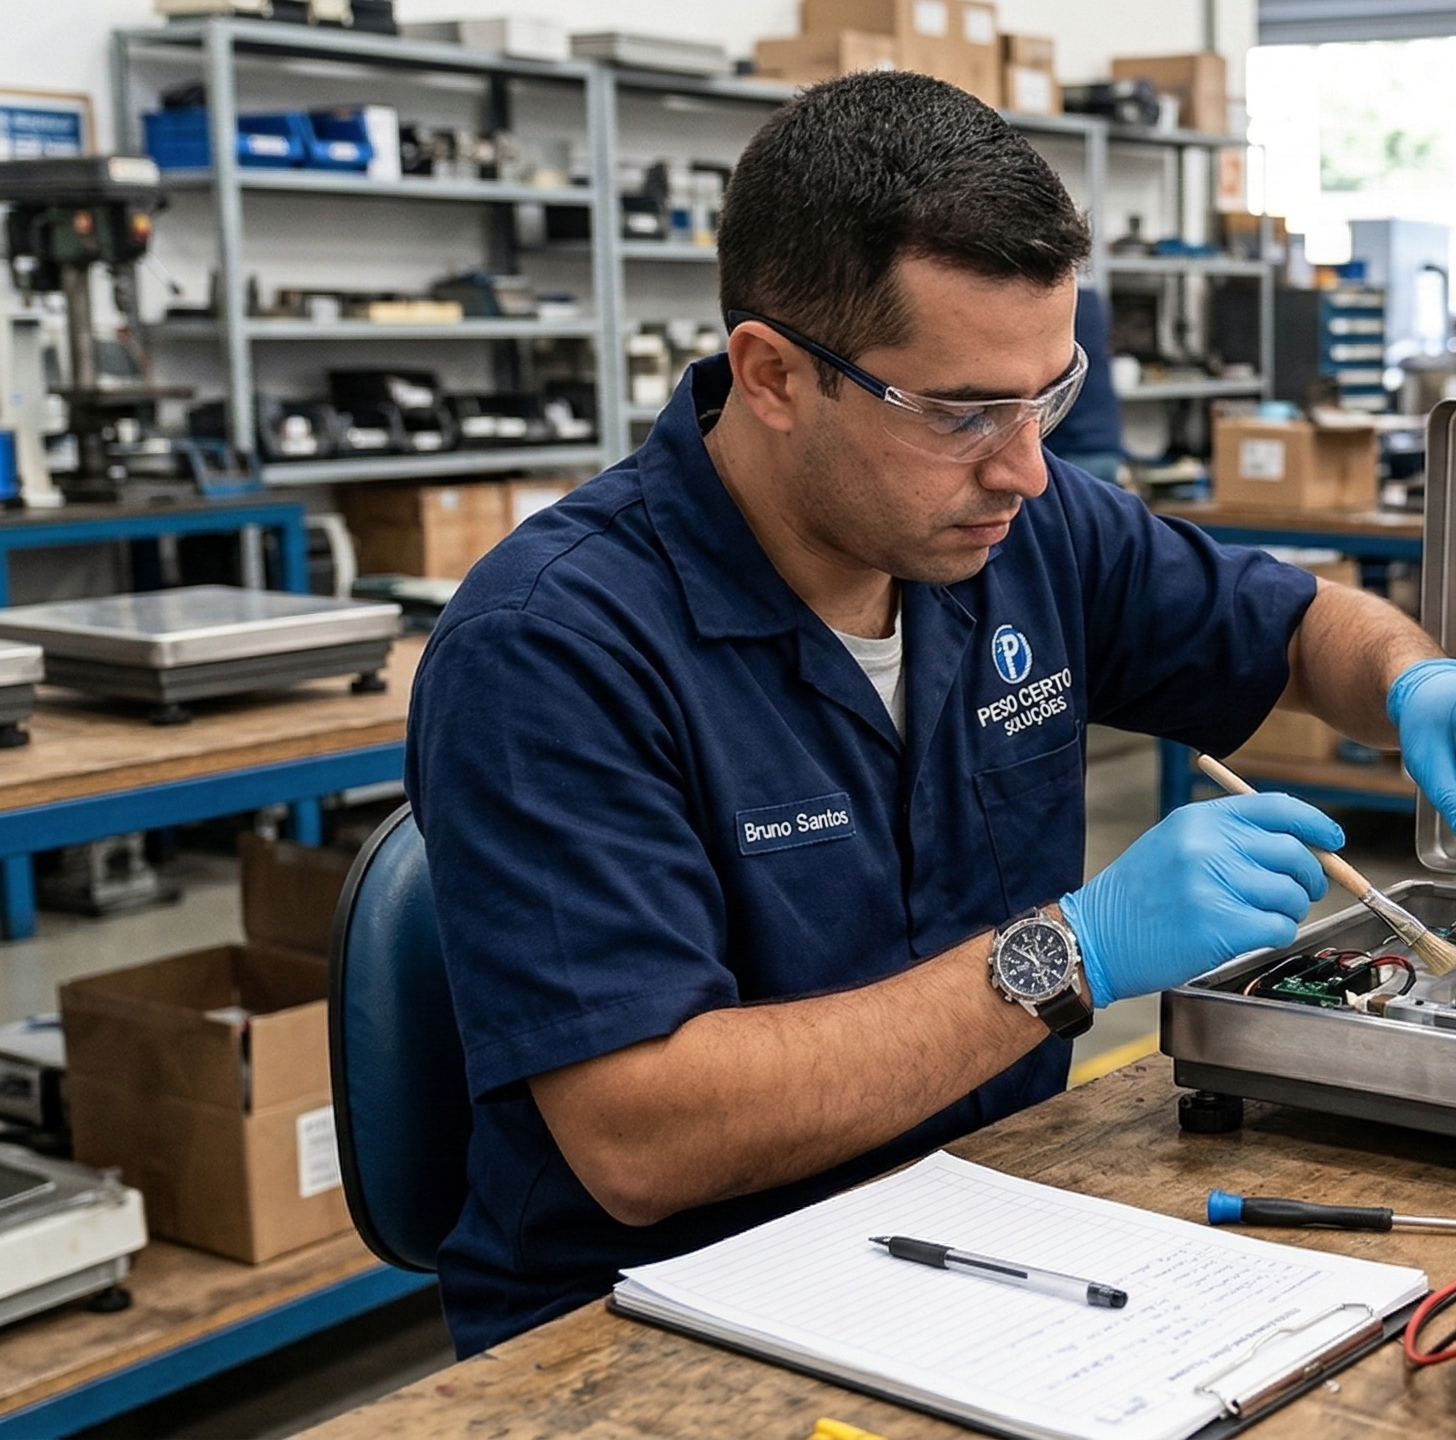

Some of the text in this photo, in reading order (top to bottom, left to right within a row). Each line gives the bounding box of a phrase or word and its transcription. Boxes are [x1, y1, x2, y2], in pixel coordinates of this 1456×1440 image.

[977, 667, 1072, 728] PESO CERTO
[744, 809, 849, 843] Bruno Santos
